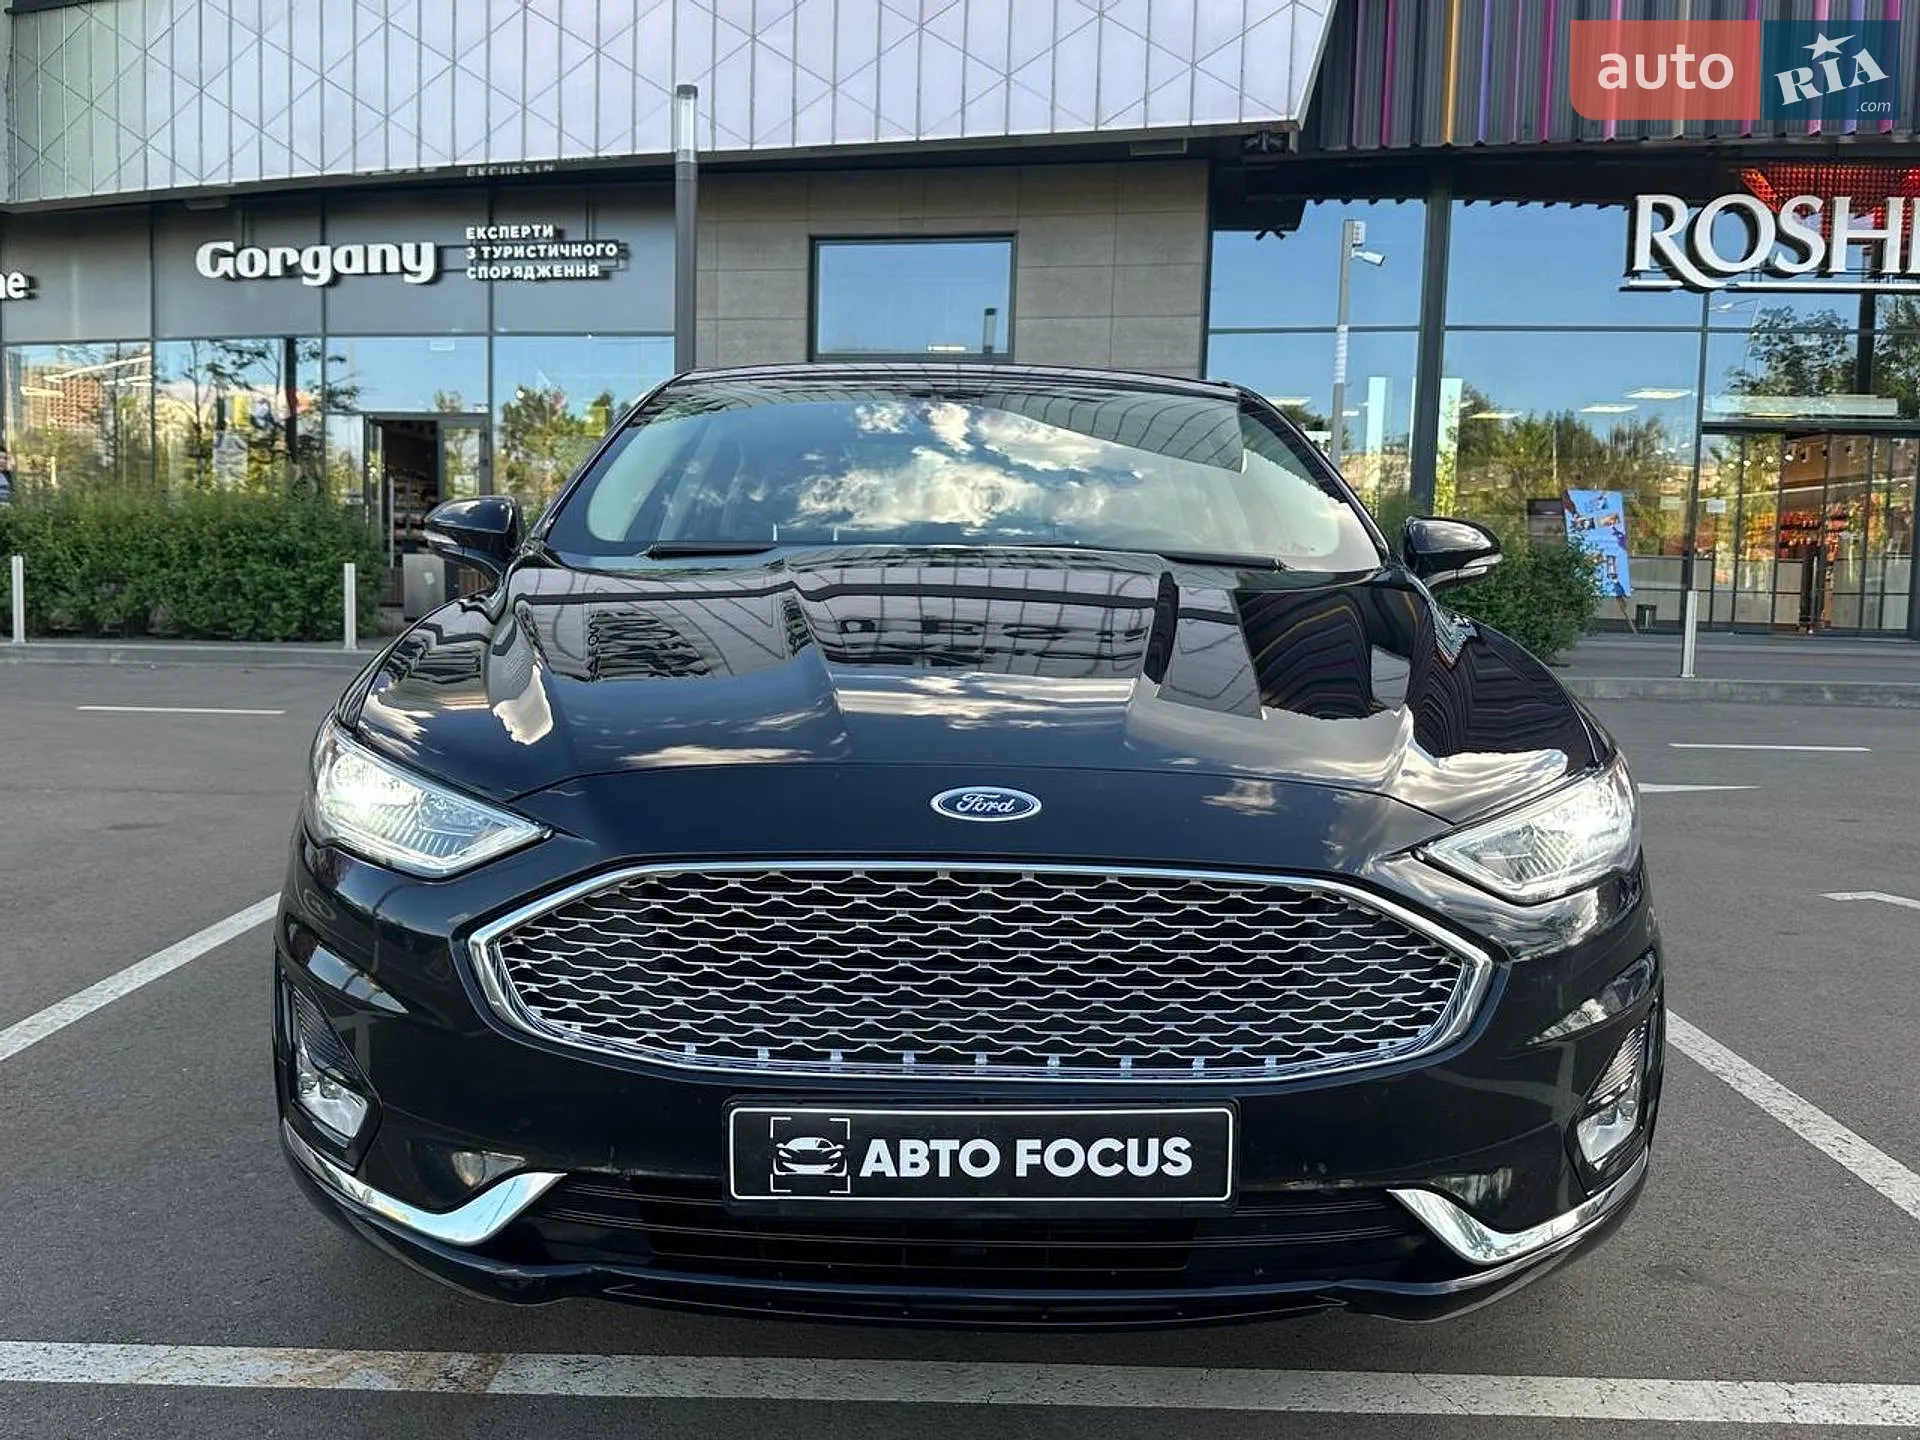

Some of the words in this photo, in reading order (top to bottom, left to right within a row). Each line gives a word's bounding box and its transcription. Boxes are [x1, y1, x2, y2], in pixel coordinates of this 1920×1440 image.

[465, 224, 555, 241] ЕКСПЕРТИ
[1630, 193, 1920, 288] ROSH
[480, 242, 619, 260] ТУРИСТИЧНОГО
[195, 241, 437, 287] Gorgany
[465, 263, 600, 281] СПОРЯДЖЕННЯ
[956, 793, 1016, 813] Ford
[1015, 1137, 1193, 1178] FOCUS
